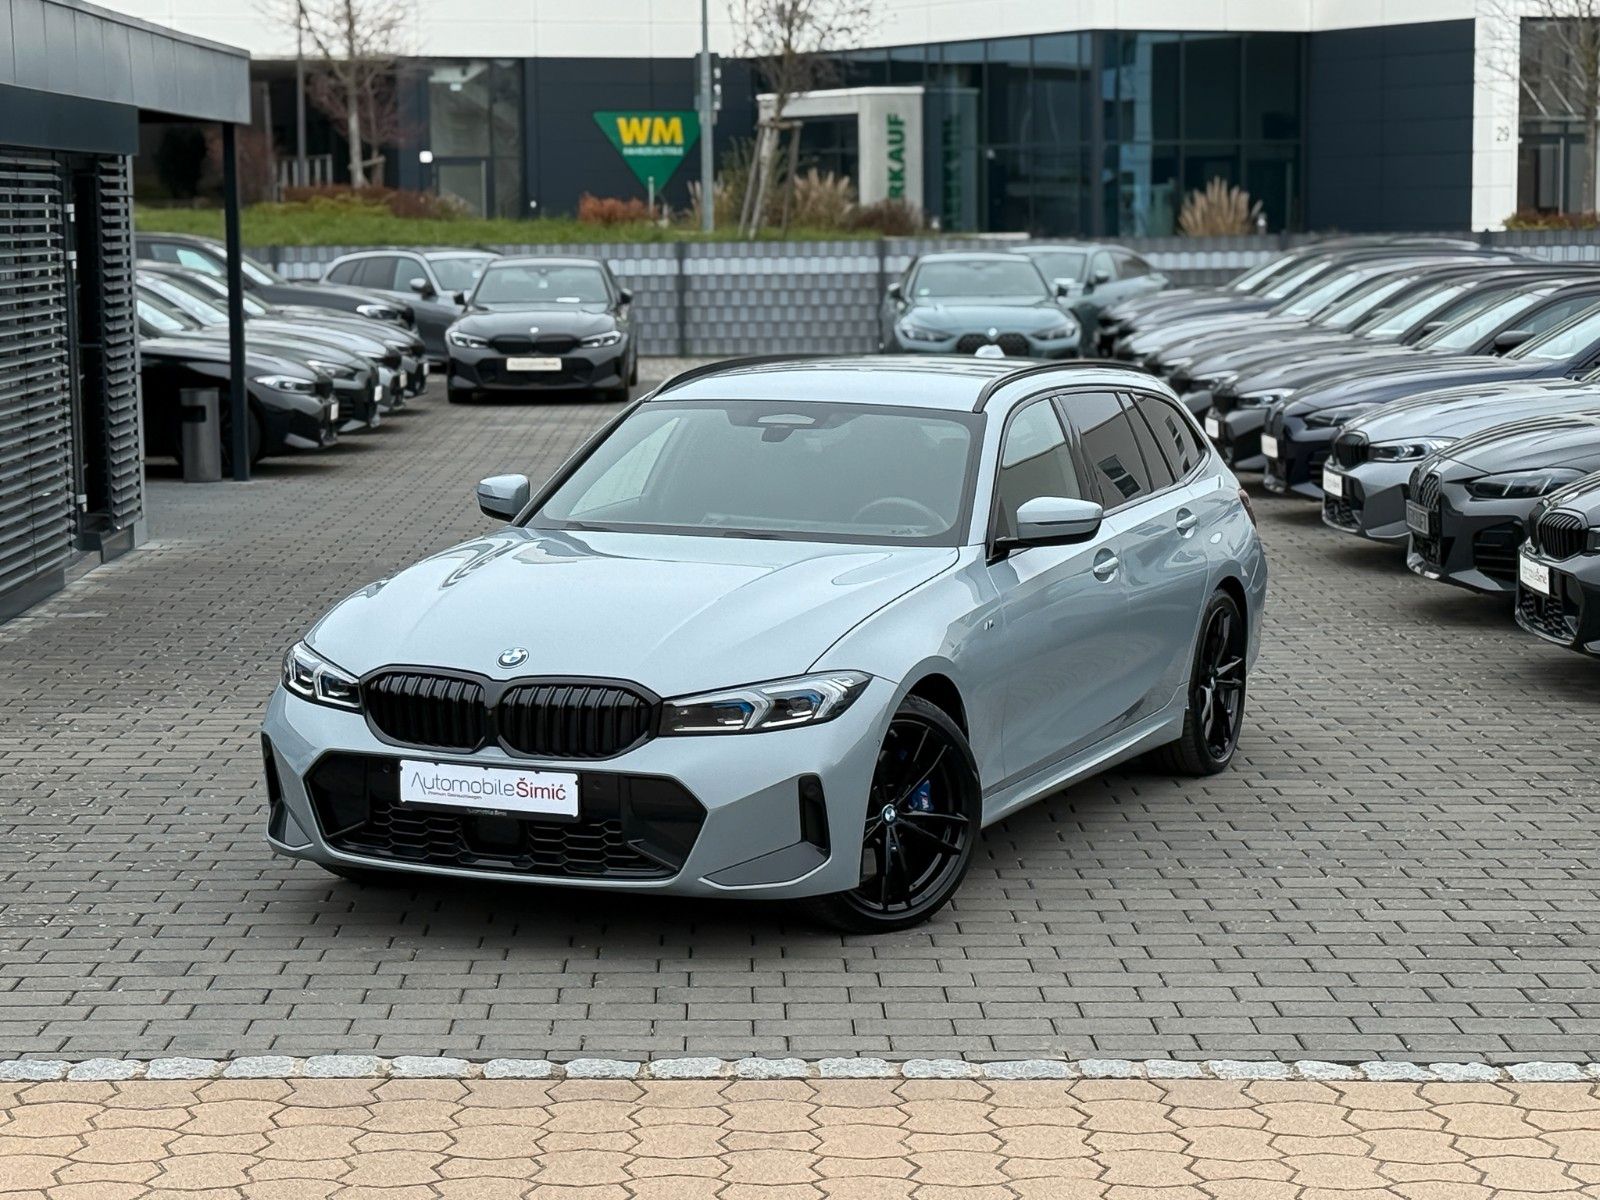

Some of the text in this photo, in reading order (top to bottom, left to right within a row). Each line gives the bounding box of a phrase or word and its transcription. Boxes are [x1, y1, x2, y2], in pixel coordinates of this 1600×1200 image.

[617, 117, 684, 146] WM
[1496, 126, 1509, 142] 29
[887, 112, 905, 199] RKAUF
